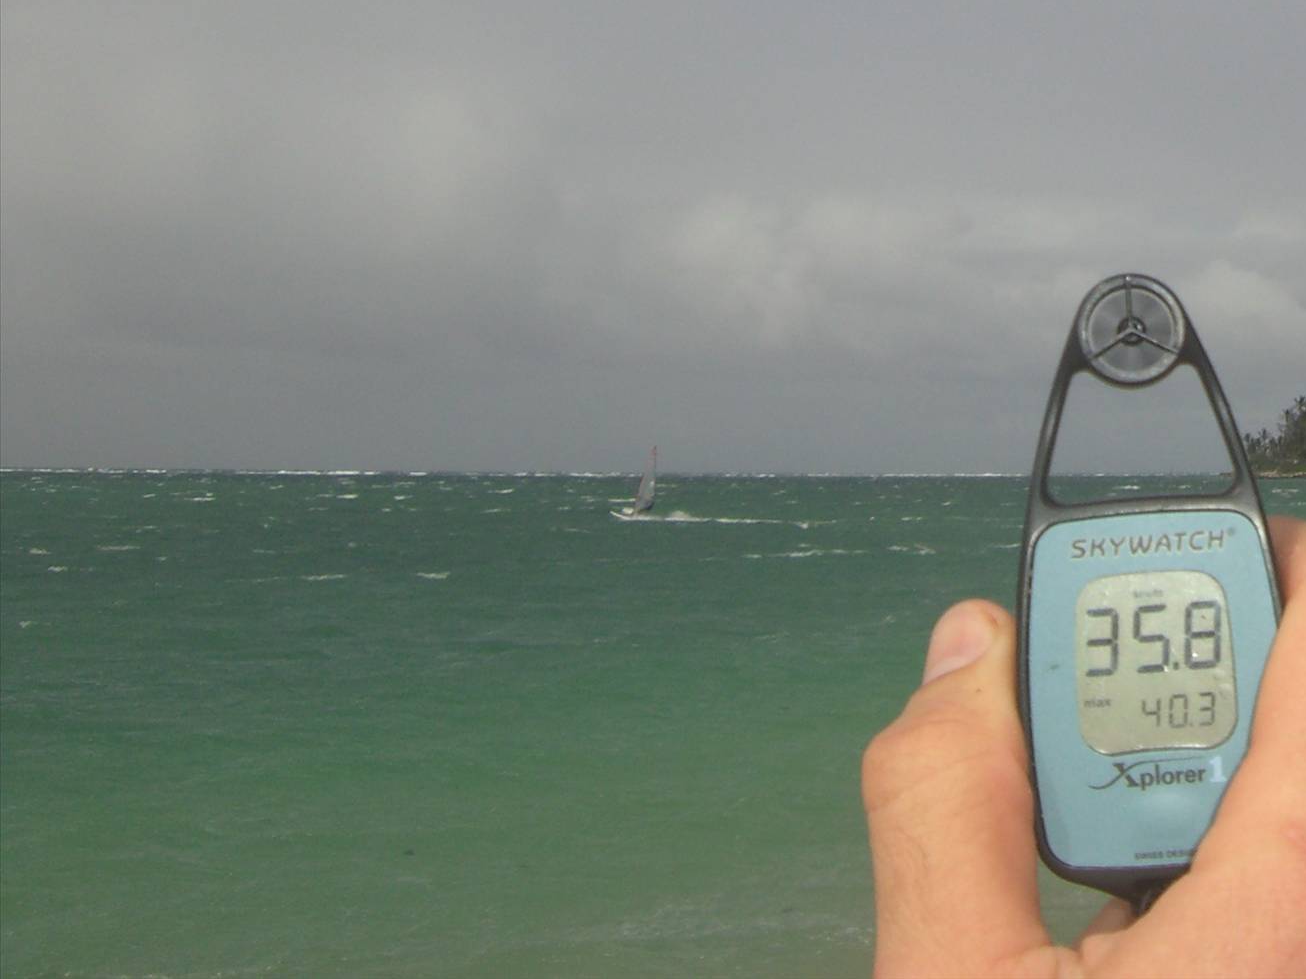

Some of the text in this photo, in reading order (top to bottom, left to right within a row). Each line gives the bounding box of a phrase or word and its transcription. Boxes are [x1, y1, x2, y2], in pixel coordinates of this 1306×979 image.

[1071, 530, 1225, 559] SKYWATCH
[1085, 601, 1221, 677] 35.8
[1084, 692, 1216, 729] max 40.3
[1088, 755, 1206, 790] Xplorer
